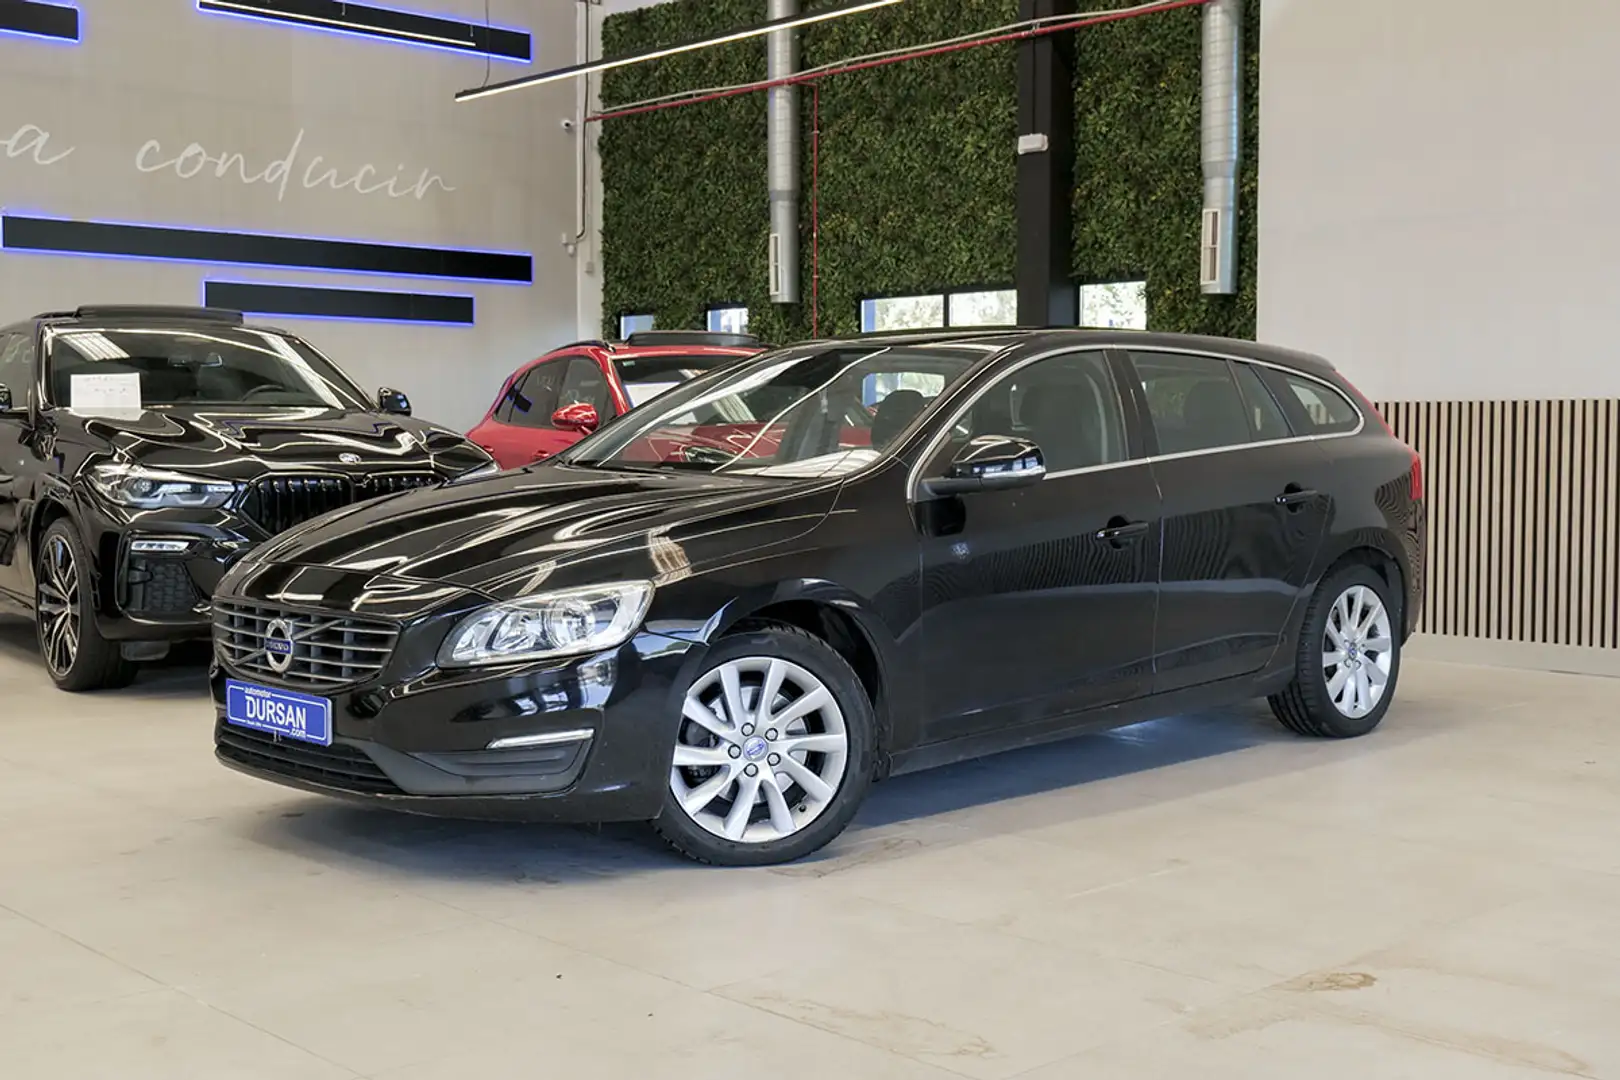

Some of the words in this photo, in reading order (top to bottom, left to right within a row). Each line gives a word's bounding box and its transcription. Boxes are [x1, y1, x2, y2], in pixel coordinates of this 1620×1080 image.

[135, 128, 457, 202] conducir
[244, 695, 307, 730] DURSAN
[290, 729, 307, 738] .com
